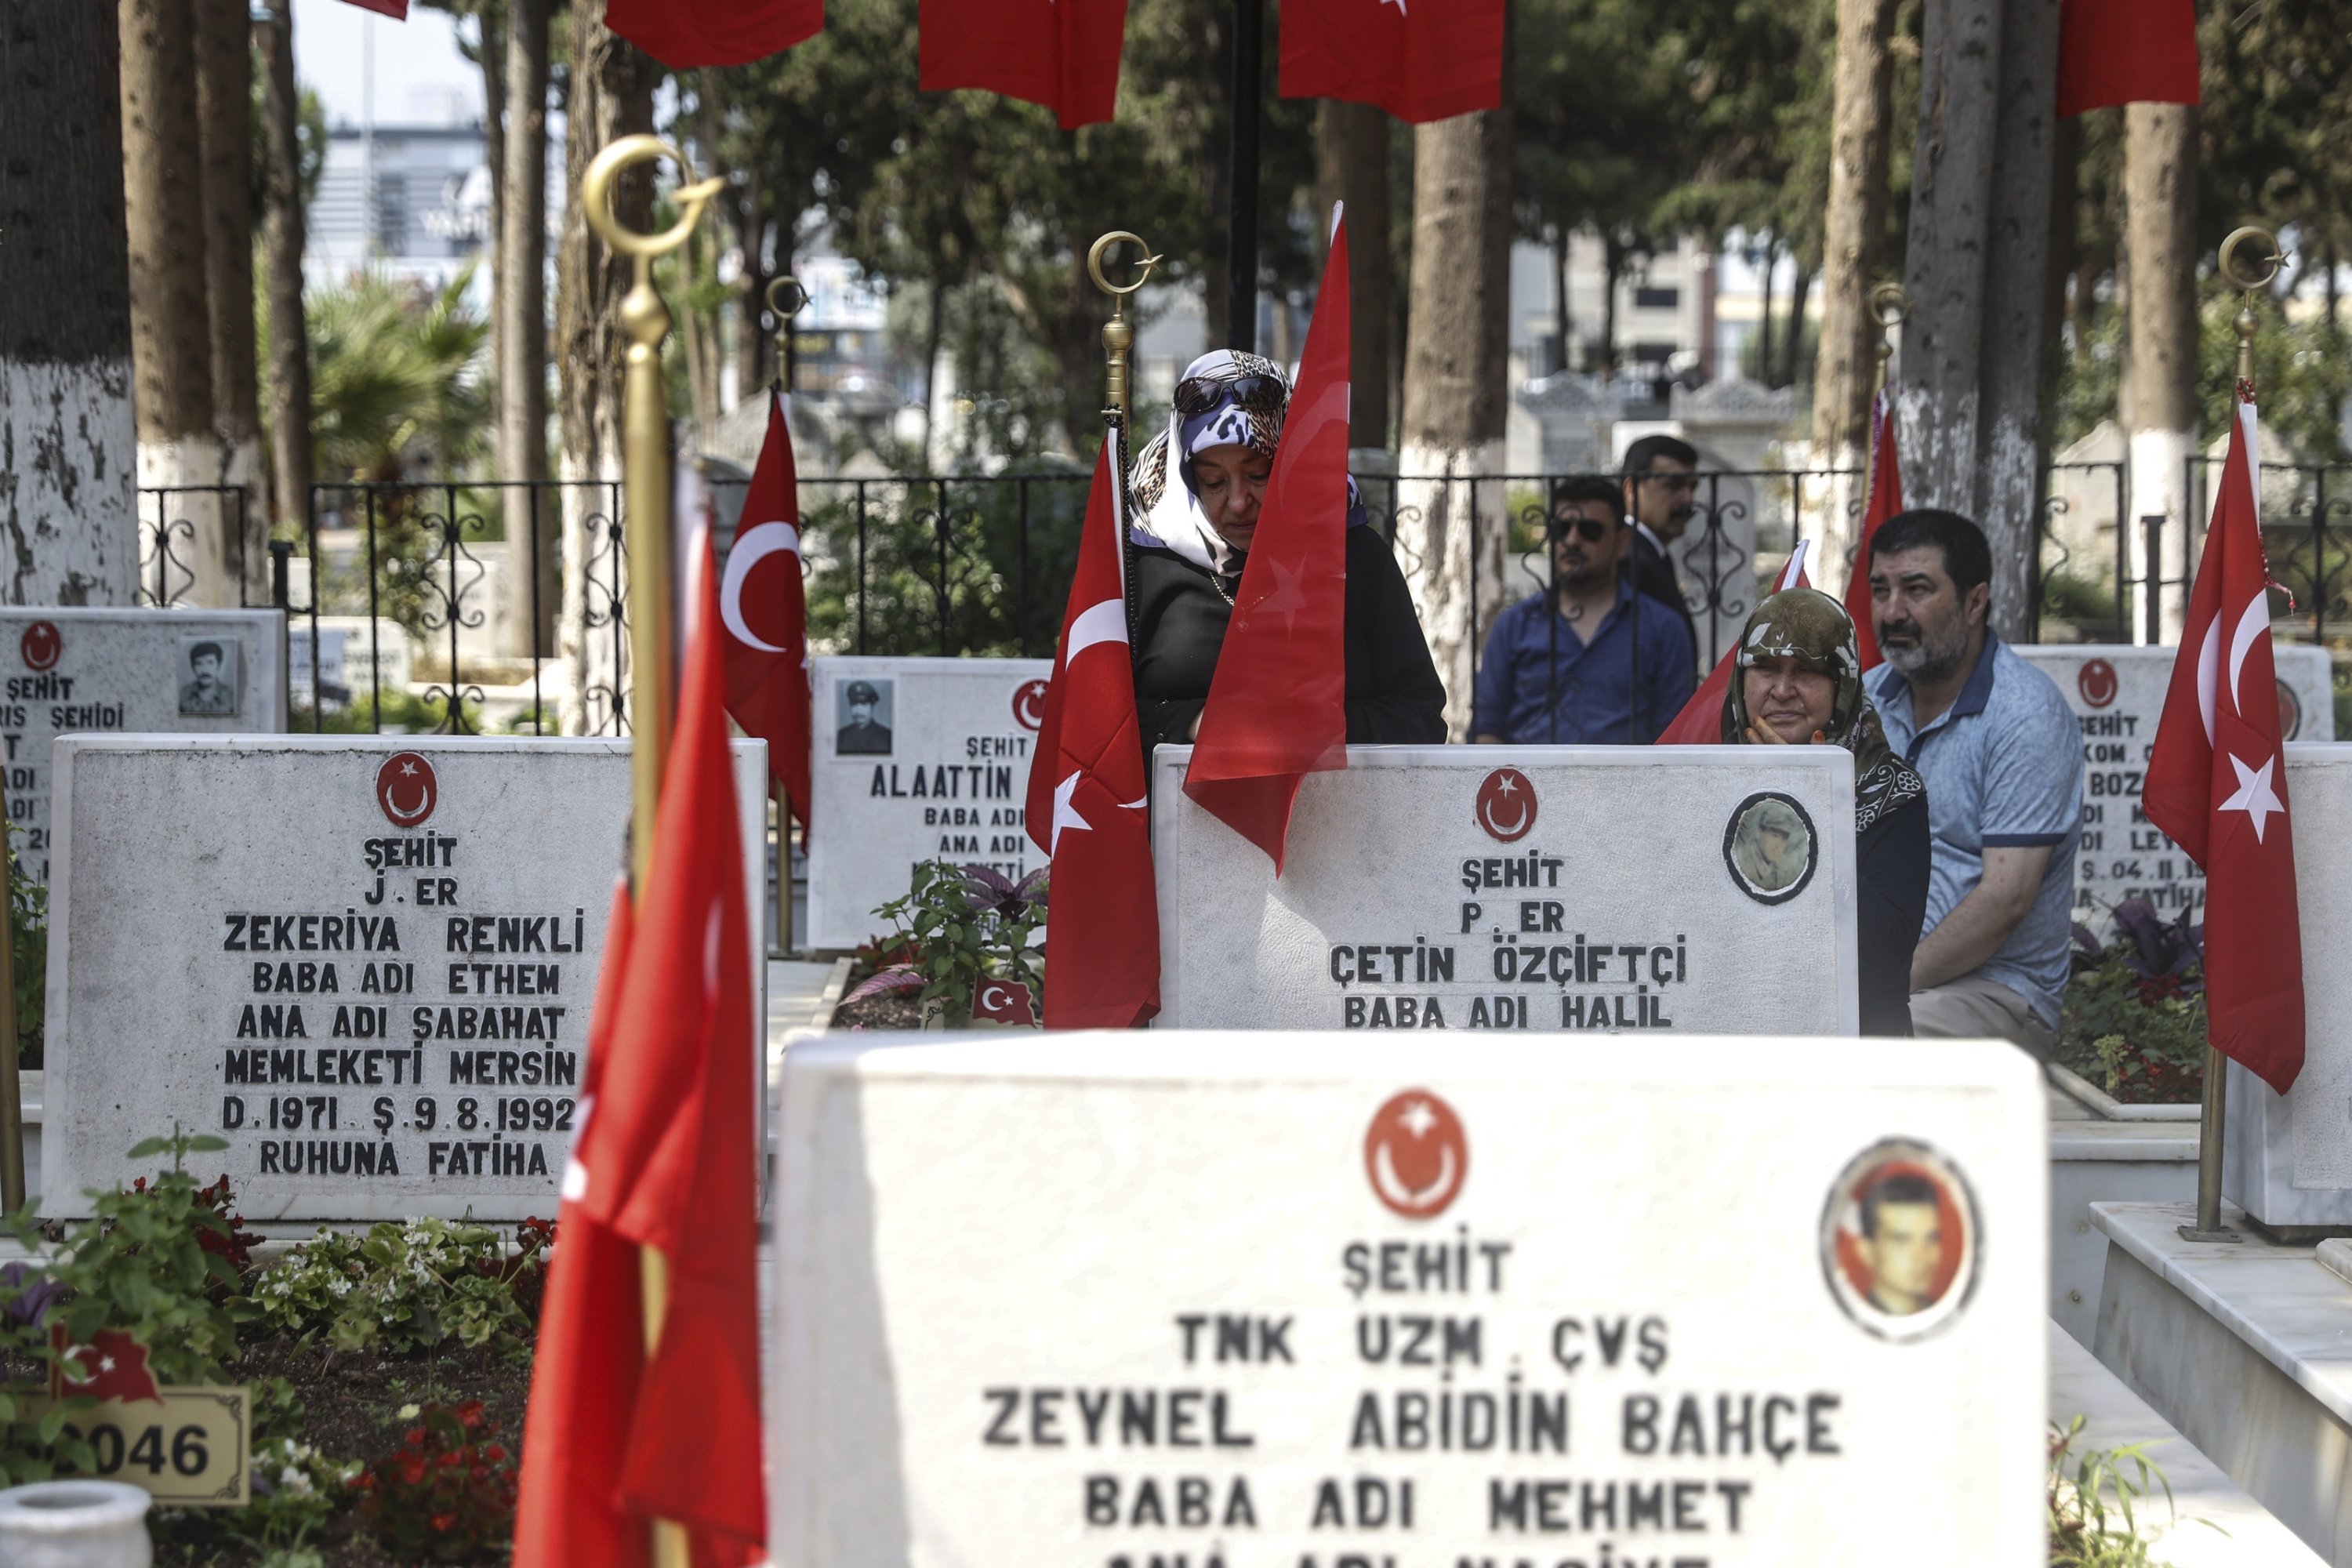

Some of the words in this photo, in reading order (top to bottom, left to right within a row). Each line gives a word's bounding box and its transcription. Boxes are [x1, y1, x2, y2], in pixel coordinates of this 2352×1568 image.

[7, 673, 74, 702] ŞEHİT
[0, 706, 26, 728] IS
[52, 702, 123, 729] ŞEHİDİ
[967, 734, 1027, 758] ŞEHİT
[871, 760, 1011, 799] ALAATTİN
[2091, 771, 2143, 797] BOZ
[925, 808, 979, 826] BABA
[364, 829, 457, 869] ŞEHİT
[941, 836, 978, 853] ANA
[991, 836, 1023, 853] ADI
[1461, 849, 1564, 894] ŞEHİT
[416, 878, 457, 906] ER
[224, 908, 400, 951] ZEKERİYA
[447, 908, 583, 953] RENKLİ
[1520, 902, 1564, 932] ER
[253, 962, 339, 993] BABA
[361, 963, 413, 994] ADI
[449, 964, 559, 995] ETHEM
[1330, 936, 1455, 988] ÇETİN
[1494, 933, 1686, 989] ÖZÇİFTÇİ
[237, 1005, 306, 1038] ANA
[332, 1006, 387, 1038] ADI
[413, 1006, 565, 1040] SABAHAT
[1345, 996, 1445, 1029] BABA
[1470, 996, 1528, 1028] ADI
[1562, 986, 1672, 1028] HALİL
[224, 1040, 423, 1085] MEMLEKETİ
[450, 1041, 576, 1085] MERSİN
[260, 1141, 399, 1176] RUHUNA
[429, 1133, 547, 1175] FATİHA
[1341, 1223, 1513, 1298] ŞEHİT
[1175, 1313, 1295, 1364] TNK
[982, 1388, 1256, 1449] ZEYNEL
[1348, 1370, 1570, 1454] ABİDİN
[1621, 1392, 1842, 1465] BAHÇE
[1083, 1475, 1258, 1528] BABA
[1310, 1476, 1414, 1530] ADI
[1488, 1479, 1751, 1534] MEHMET
